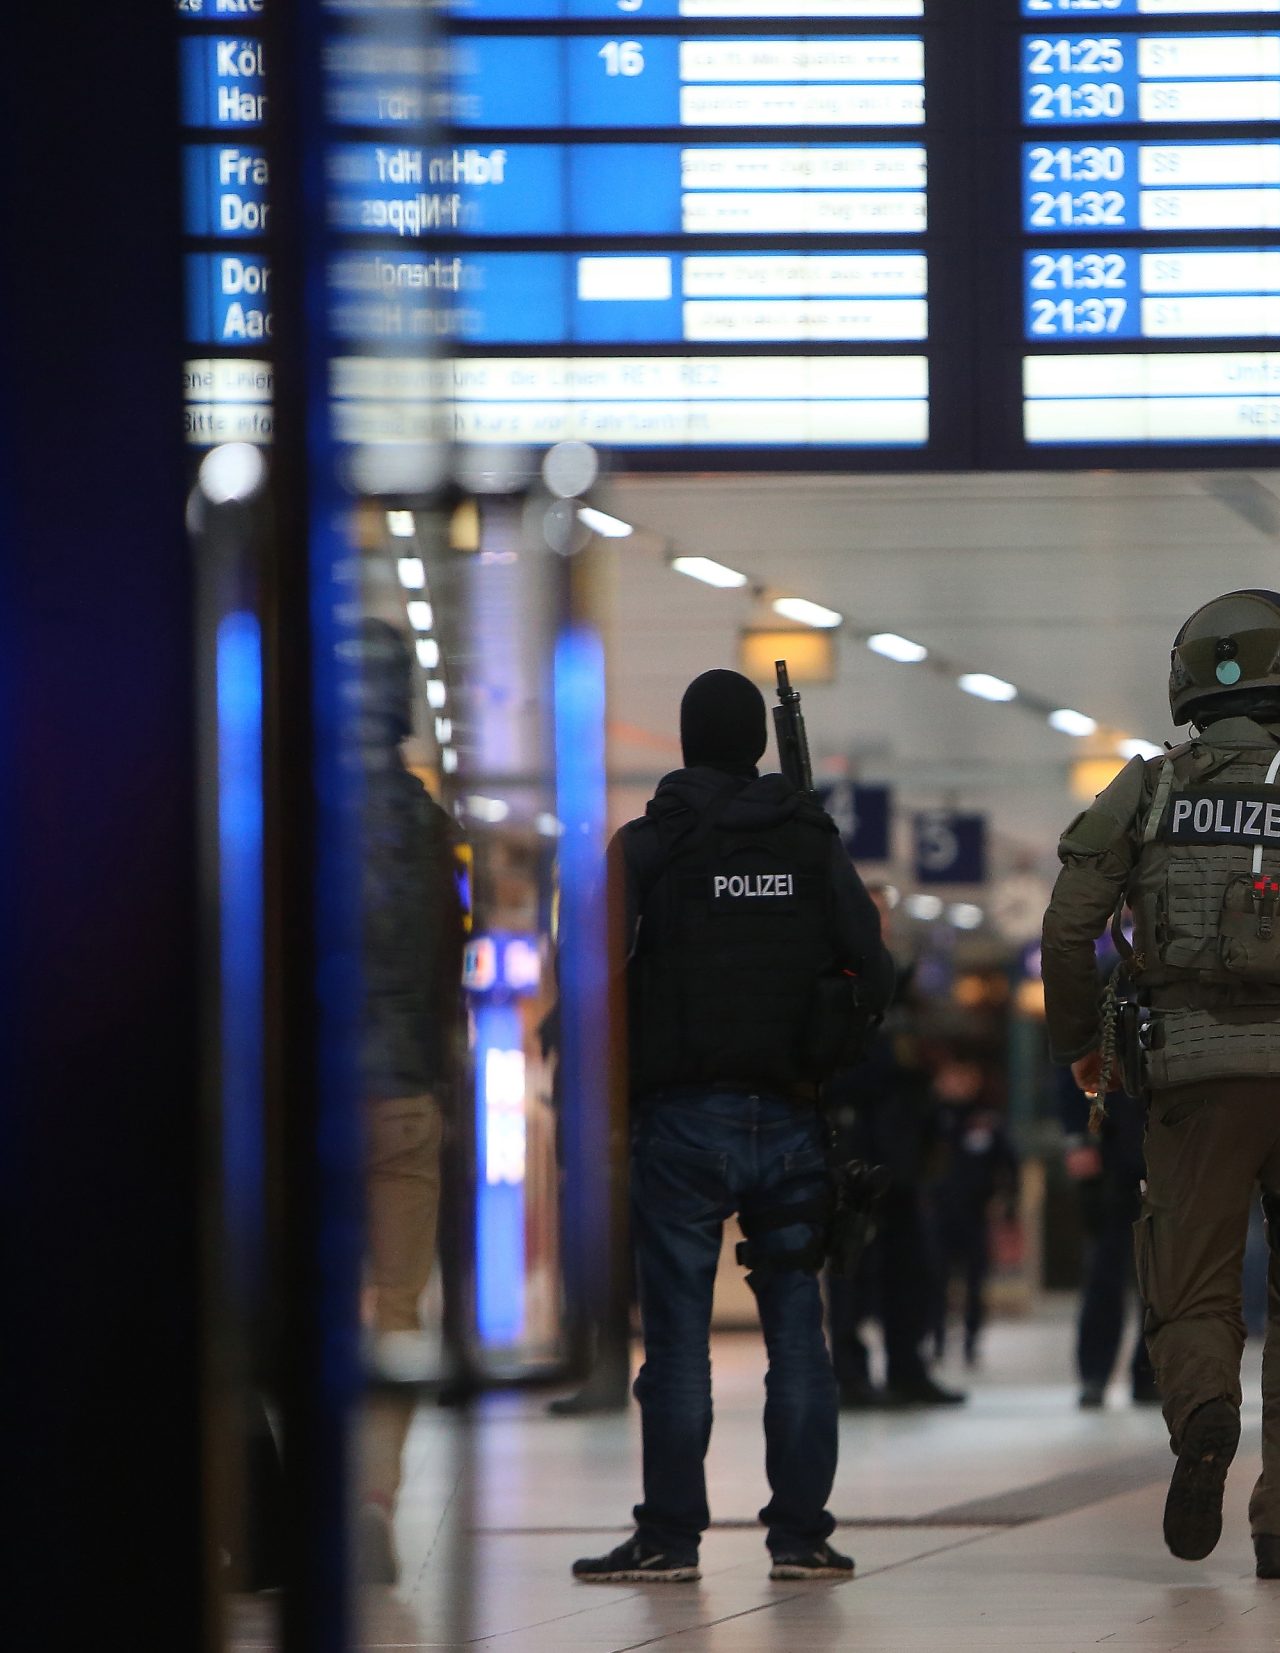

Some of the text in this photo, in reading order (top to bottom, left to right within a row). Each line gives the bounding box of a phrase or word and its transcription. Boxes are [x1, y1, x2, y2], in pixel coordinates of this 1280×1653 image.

[598, 40, 645, 77] 16
[1028, 38, 1124, 74] 21:25
[1028, 83, 1125, 118] 21:30
[1028, 147, 1125, 182] 21:30
[1029, 190, 1126, 226] 21:32
[1030, 253, 1127, 290] 21:32
[1030, 297, 1127, 334] 21:37
[714, 874, 794, 898] POLIZEI
